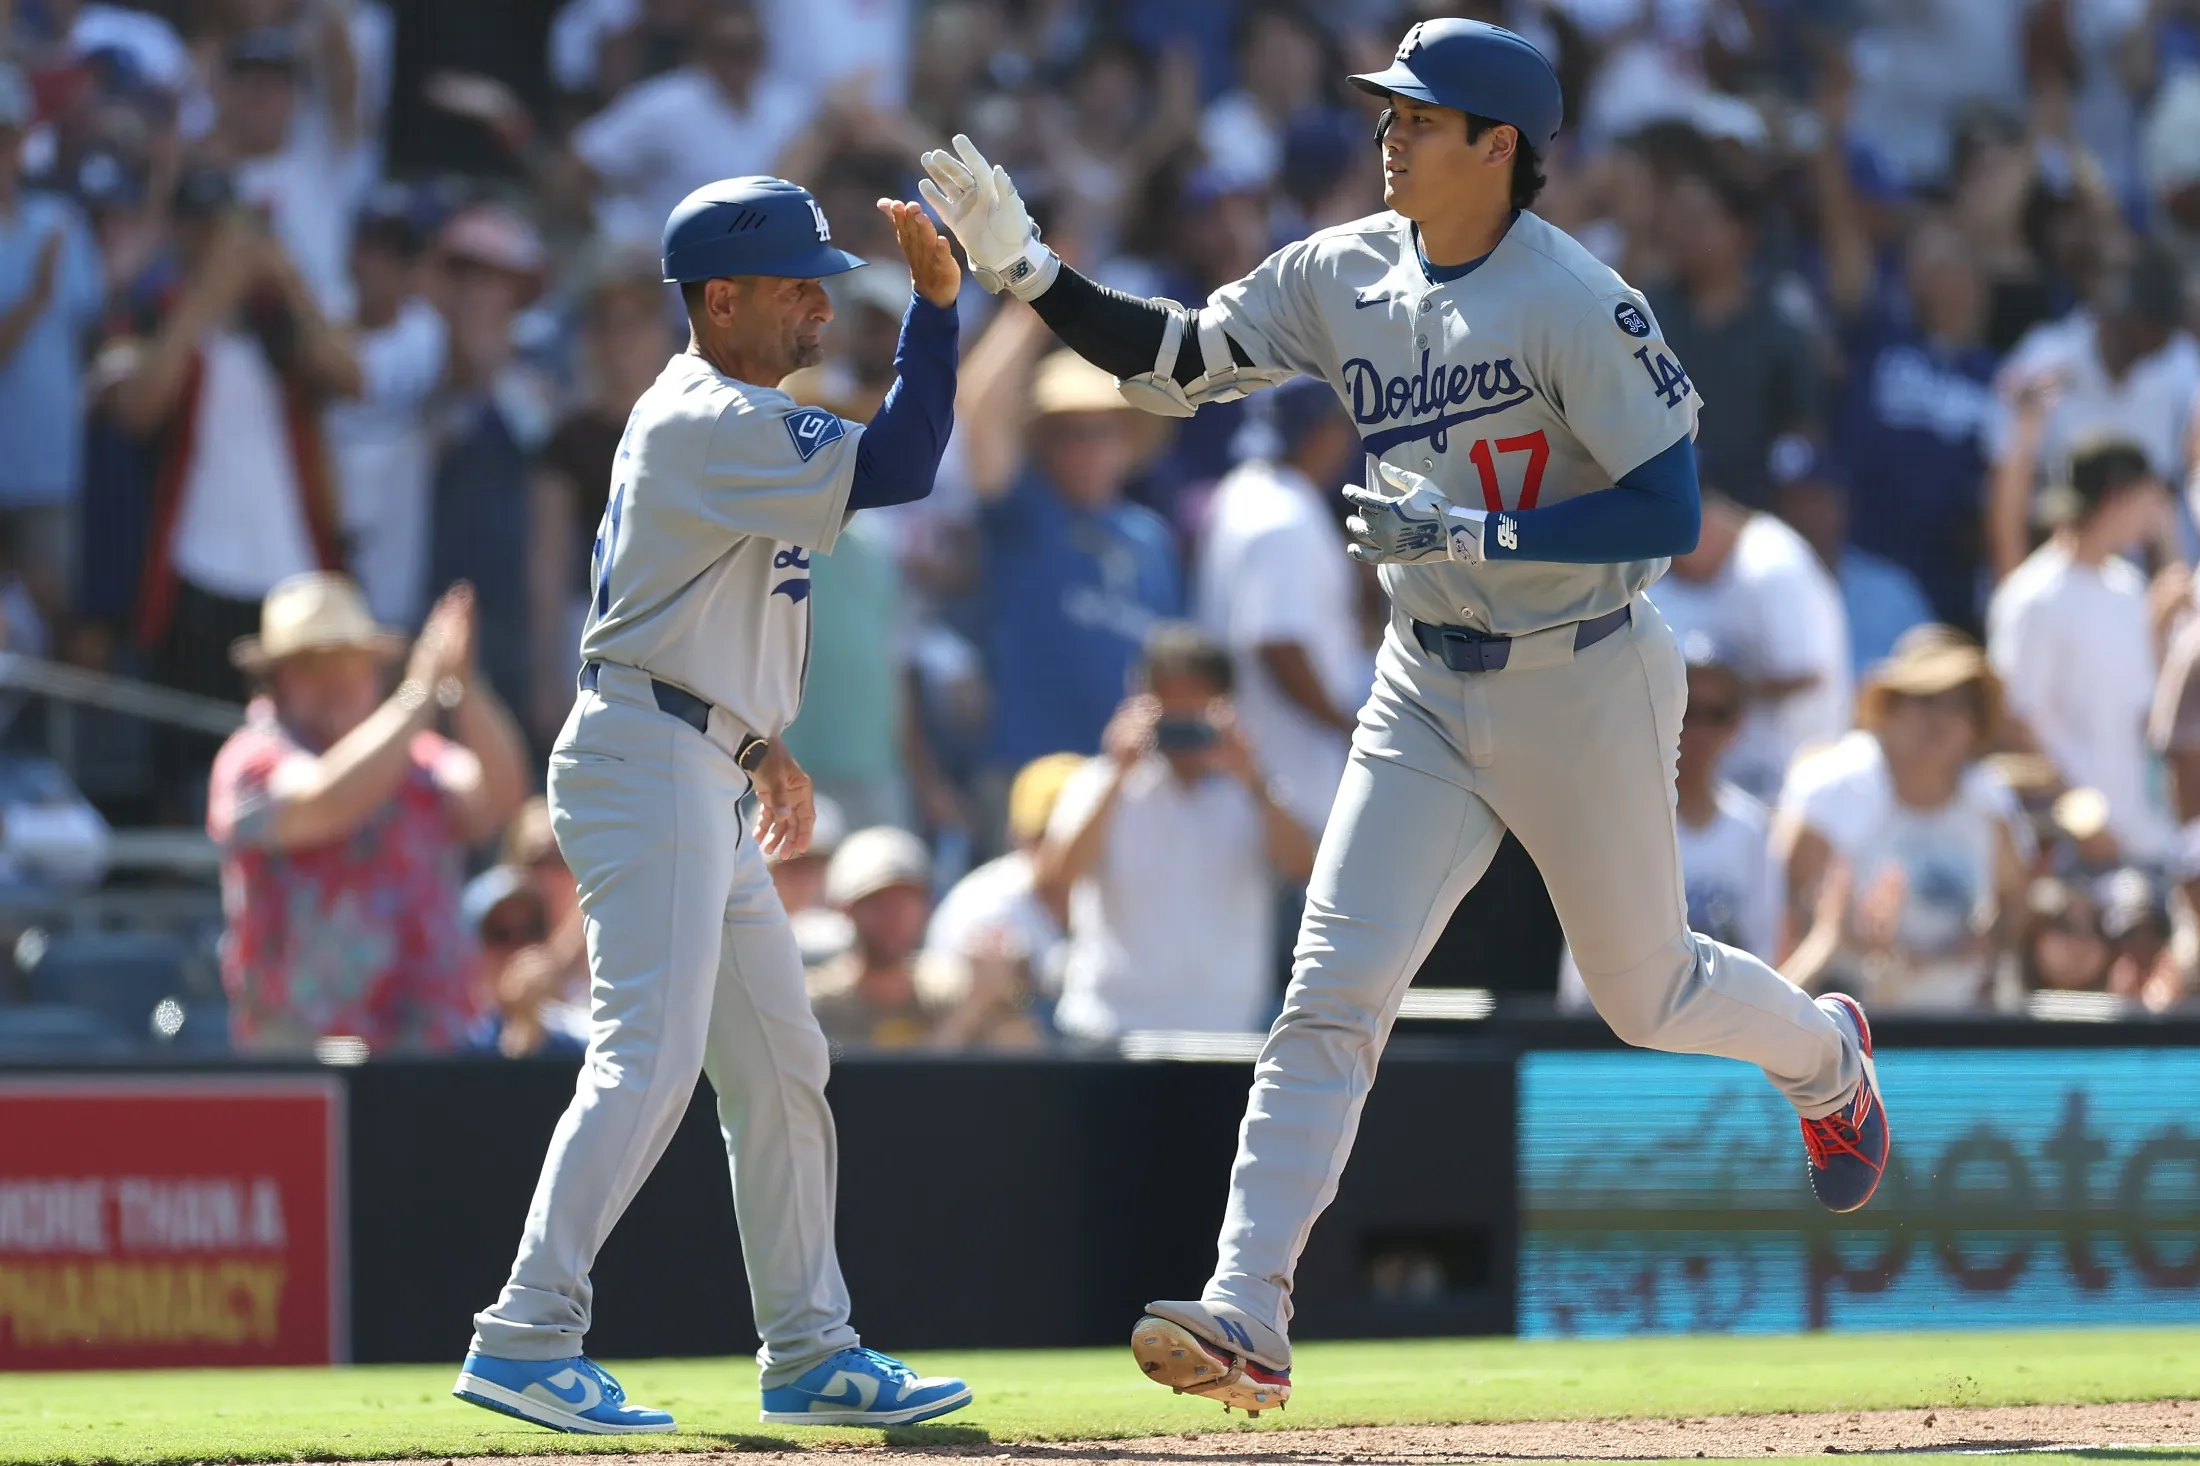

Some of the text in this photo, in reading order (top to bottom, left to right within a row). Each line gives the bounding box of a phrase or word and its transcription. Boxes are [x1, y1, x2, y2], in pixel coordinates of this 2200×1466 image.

[805, 199, 831, 242] LA
[1623, 313, 1647, 333] 34
[1342, 347, 1534, 454] Dodgers
[1633, 344, 1691, 409] LA
[1469, 428, 1550, 512] 17
[117, 1175, 241, 1252] THAN
[251, 1175, 288, 1250] A
